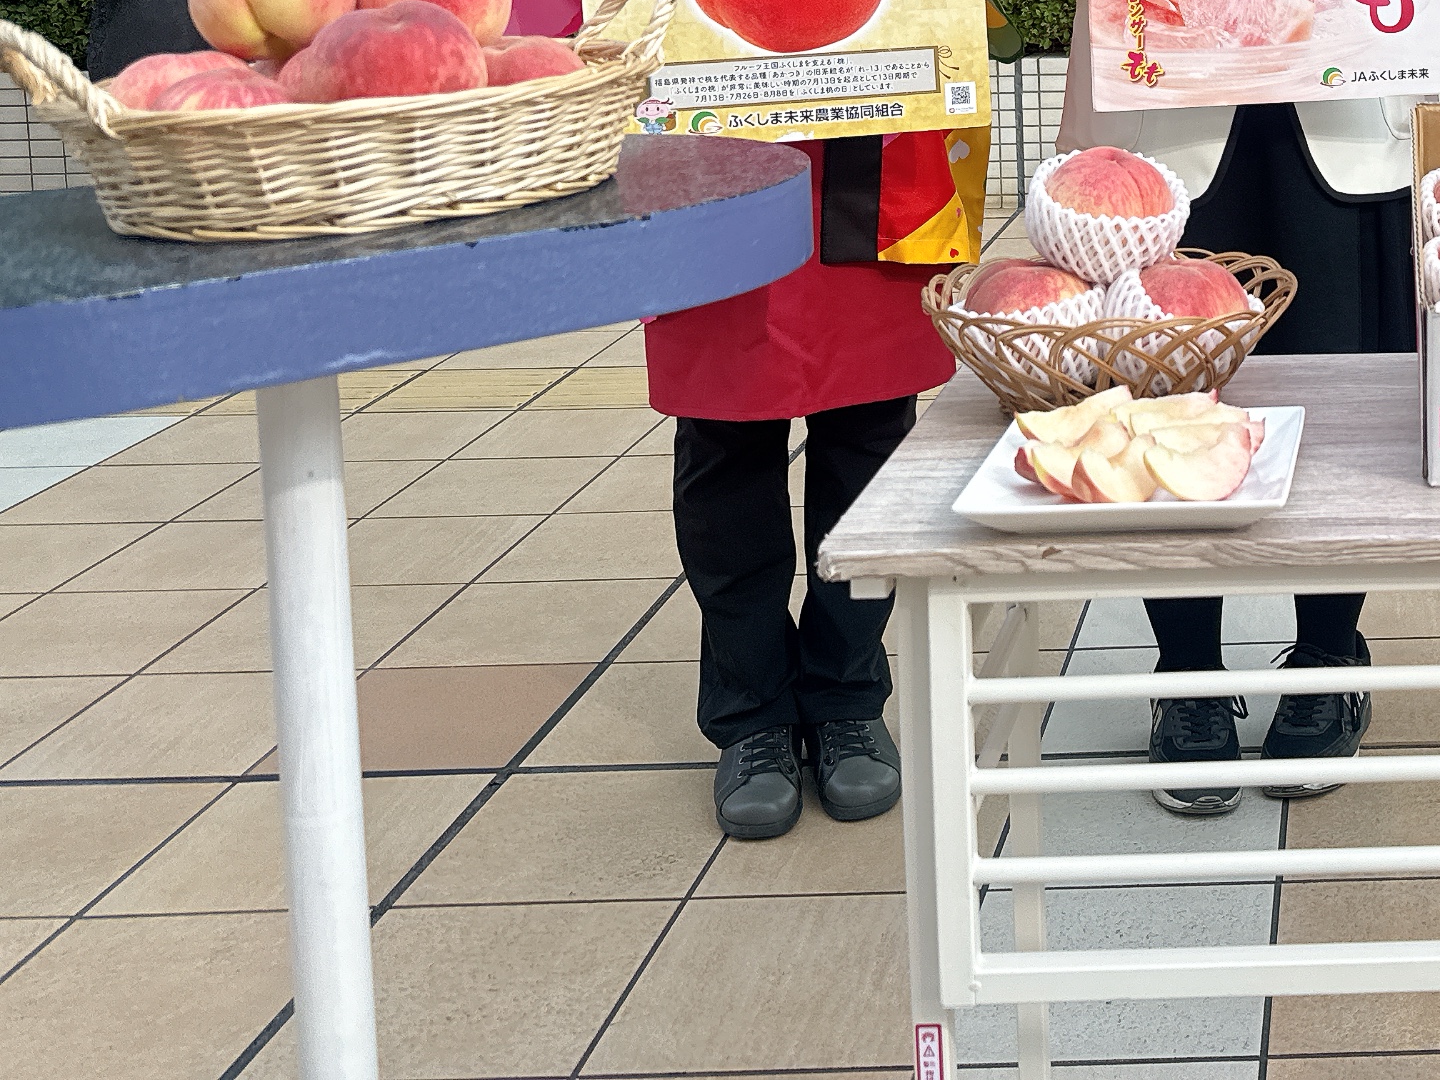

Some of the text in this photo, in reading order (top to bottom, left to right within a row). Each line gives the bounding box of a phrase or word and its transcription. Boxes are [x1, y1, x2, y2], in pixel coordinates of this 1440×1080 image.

[1351, 68, 1430, 83] JAふくしま未来
[728, 102, 904, 128] ふくしま未来農業協同組合
